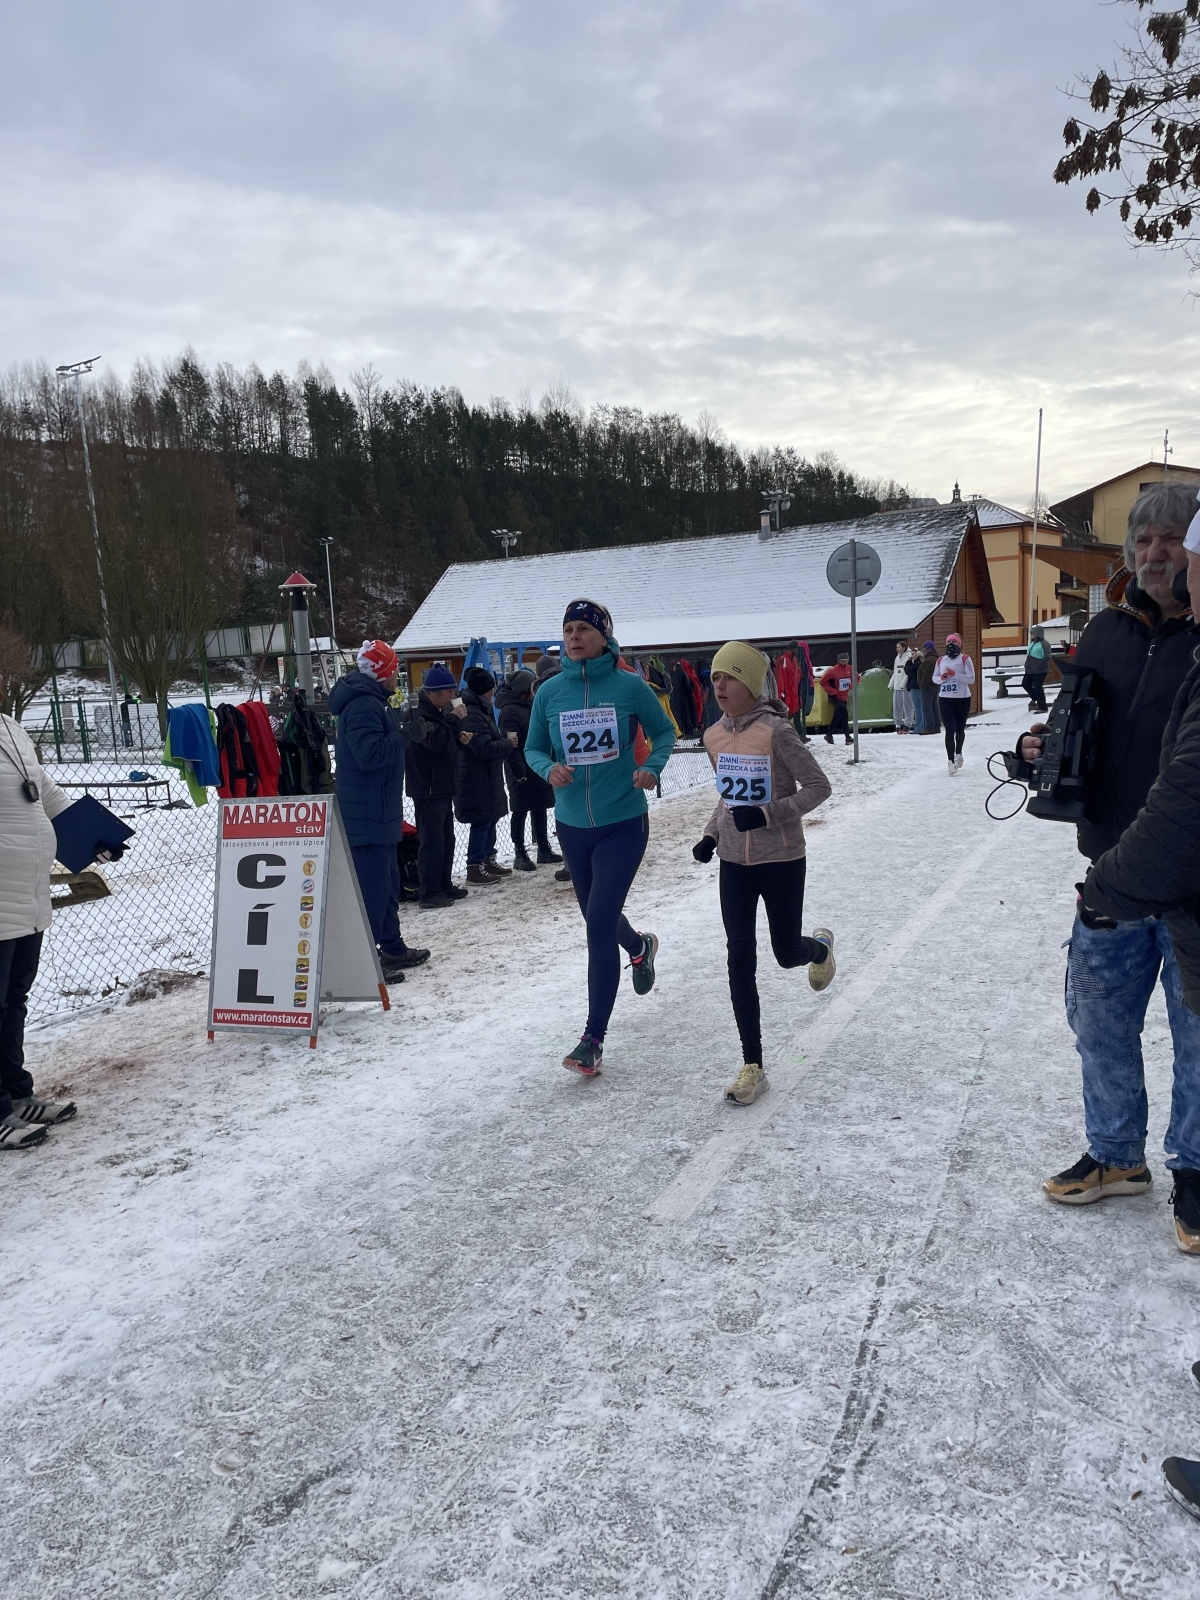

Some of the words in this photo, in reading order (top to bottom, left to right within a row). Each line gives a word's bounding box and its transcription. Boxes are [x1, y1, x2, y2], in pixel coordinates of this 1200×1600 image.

[942, 684, 957, 692] 282
[562, 711, 585, 721] ZIMNÍ
[566, 728, 615, 754] 224
[719, 756, 739, 764] ZIMNÍ
[721, 776, 767, 801] 225
[223, 802, 327, 825] MARATON
[295, 824, 322, 834] stav
[222, 840, 269, 849] tělovýchovná
[272, 840, 300, 848] jednota
[303, 839, 325, 847] Úpice
[236, 853, 287, 1004] CÍL
[216, 1012, 309, 1025] www.maratonstav.cz
